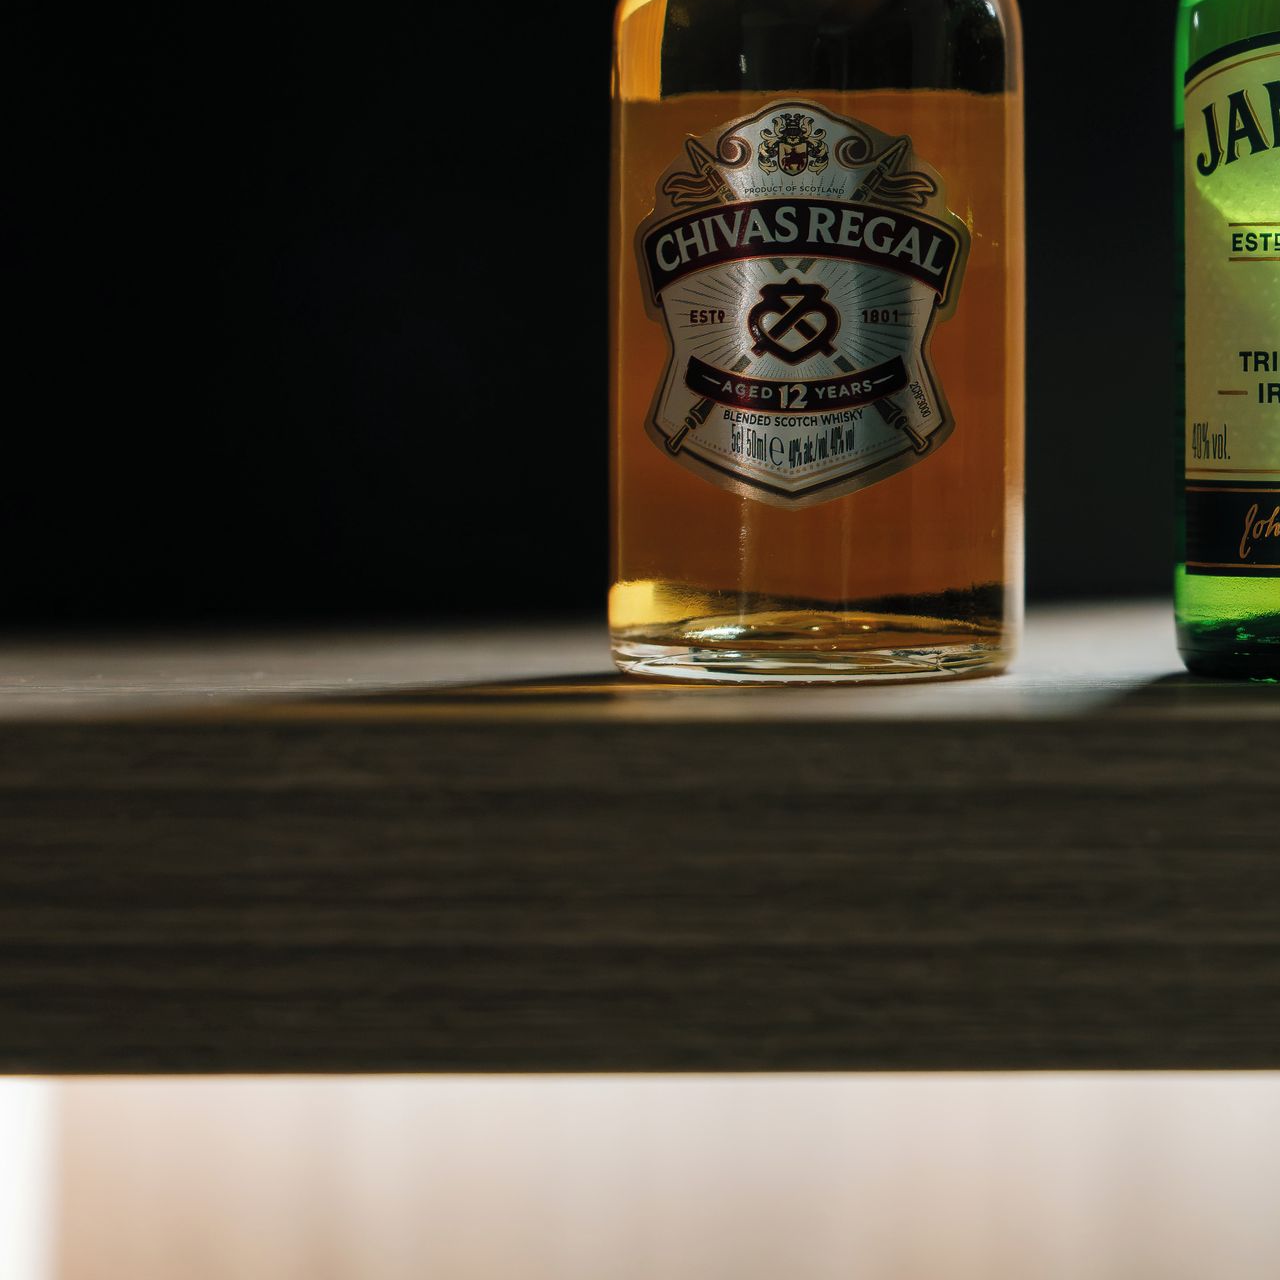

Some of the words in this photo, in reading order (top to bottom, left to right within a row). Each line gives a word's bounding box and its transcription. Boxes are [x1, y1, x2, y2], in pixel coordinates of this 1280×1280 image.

[744, 186, 783, 195] PRODUCT
[785, 185, 798, 193] OF
[799, 185, 845, 195] SCOTLAND
[655, 206, 799, 272] CHIVAS
[806, 207, 945, 276] REGAL
[862, 310, 899, 323] 1801
[721, 380, 773, 400] AGED
[778, 384, 808, 409] 12
[814, 380, 873, 400] YEARS
[723, 410, 770, 427] BLENDED
[774, 416, 818, 427] SCOTCH
[820, 409, 864, 425] WHISKY
[1212, 423, 1231, 460] vol.
